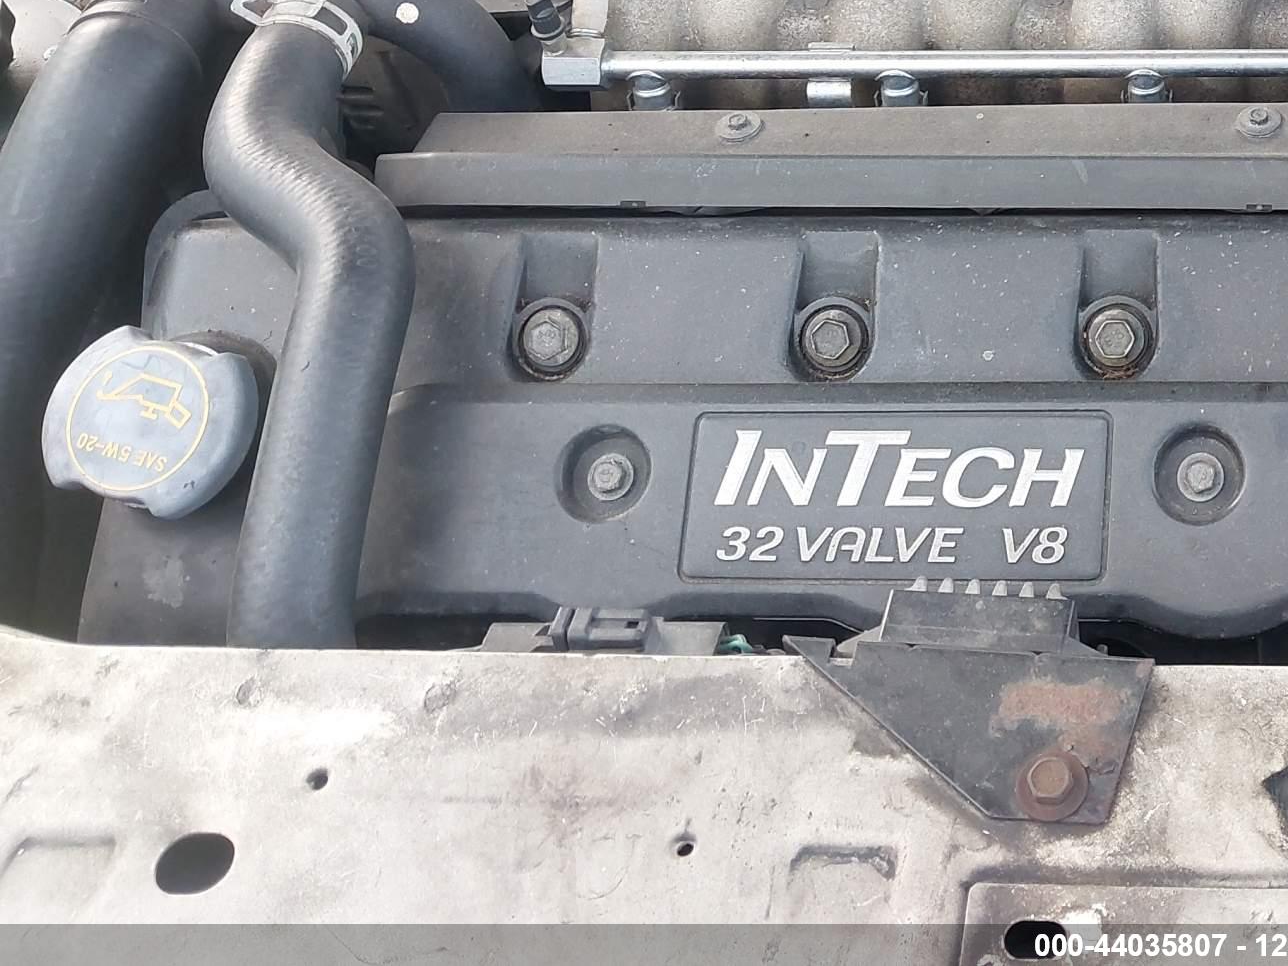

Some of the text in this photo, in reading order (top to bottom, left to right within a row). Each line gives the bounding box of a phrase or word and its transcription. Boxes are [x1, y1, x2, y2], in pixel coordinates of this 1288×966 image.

[76, 432, 168, 472] SAE 5W-20
[713, 430, 1086, 508] INTECH
[716, 526, 1069, 564] 32 VALVE V8
